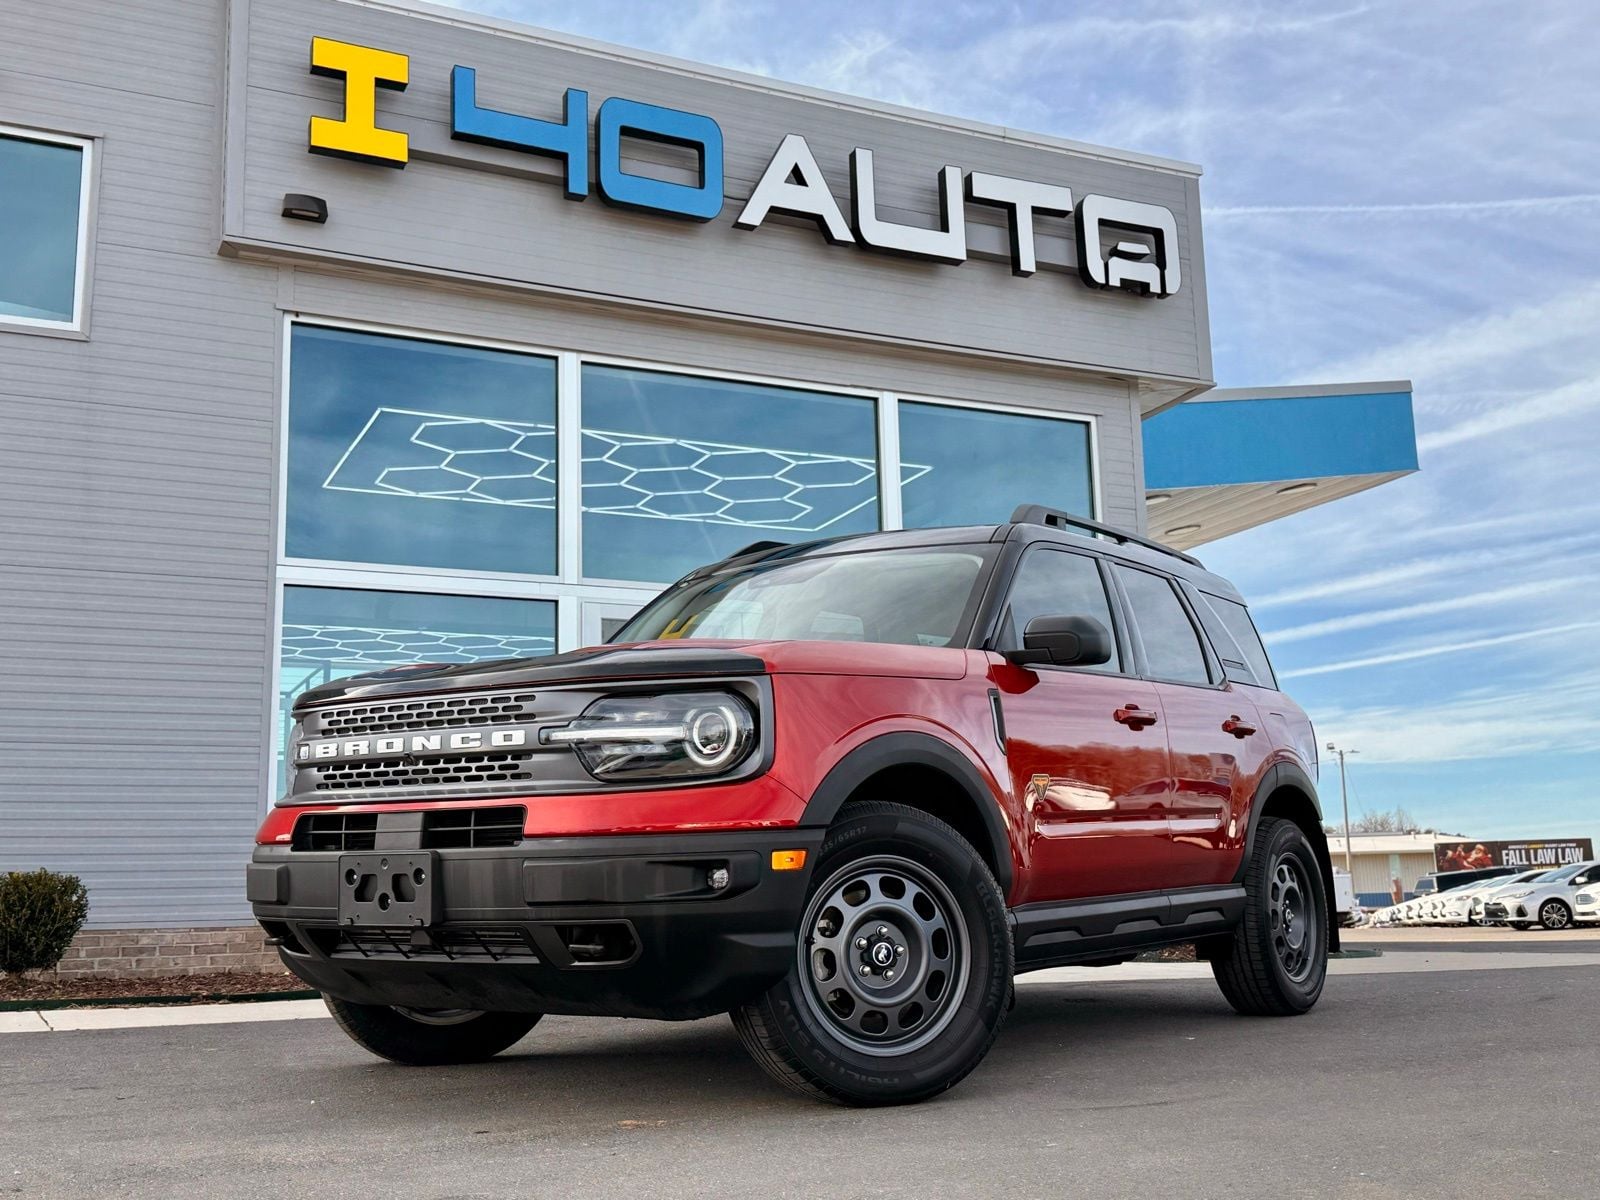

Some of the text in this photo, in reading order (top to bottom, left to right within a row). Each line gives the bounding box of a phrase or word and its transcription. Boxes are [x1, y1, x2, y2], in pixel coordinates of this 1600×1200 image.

[310, 36, 1182, 298] I 40 AUTO
[315, 729, 525, 758] BRONCO
[1502, 847, 1583, 866] FALL LAW LAW
